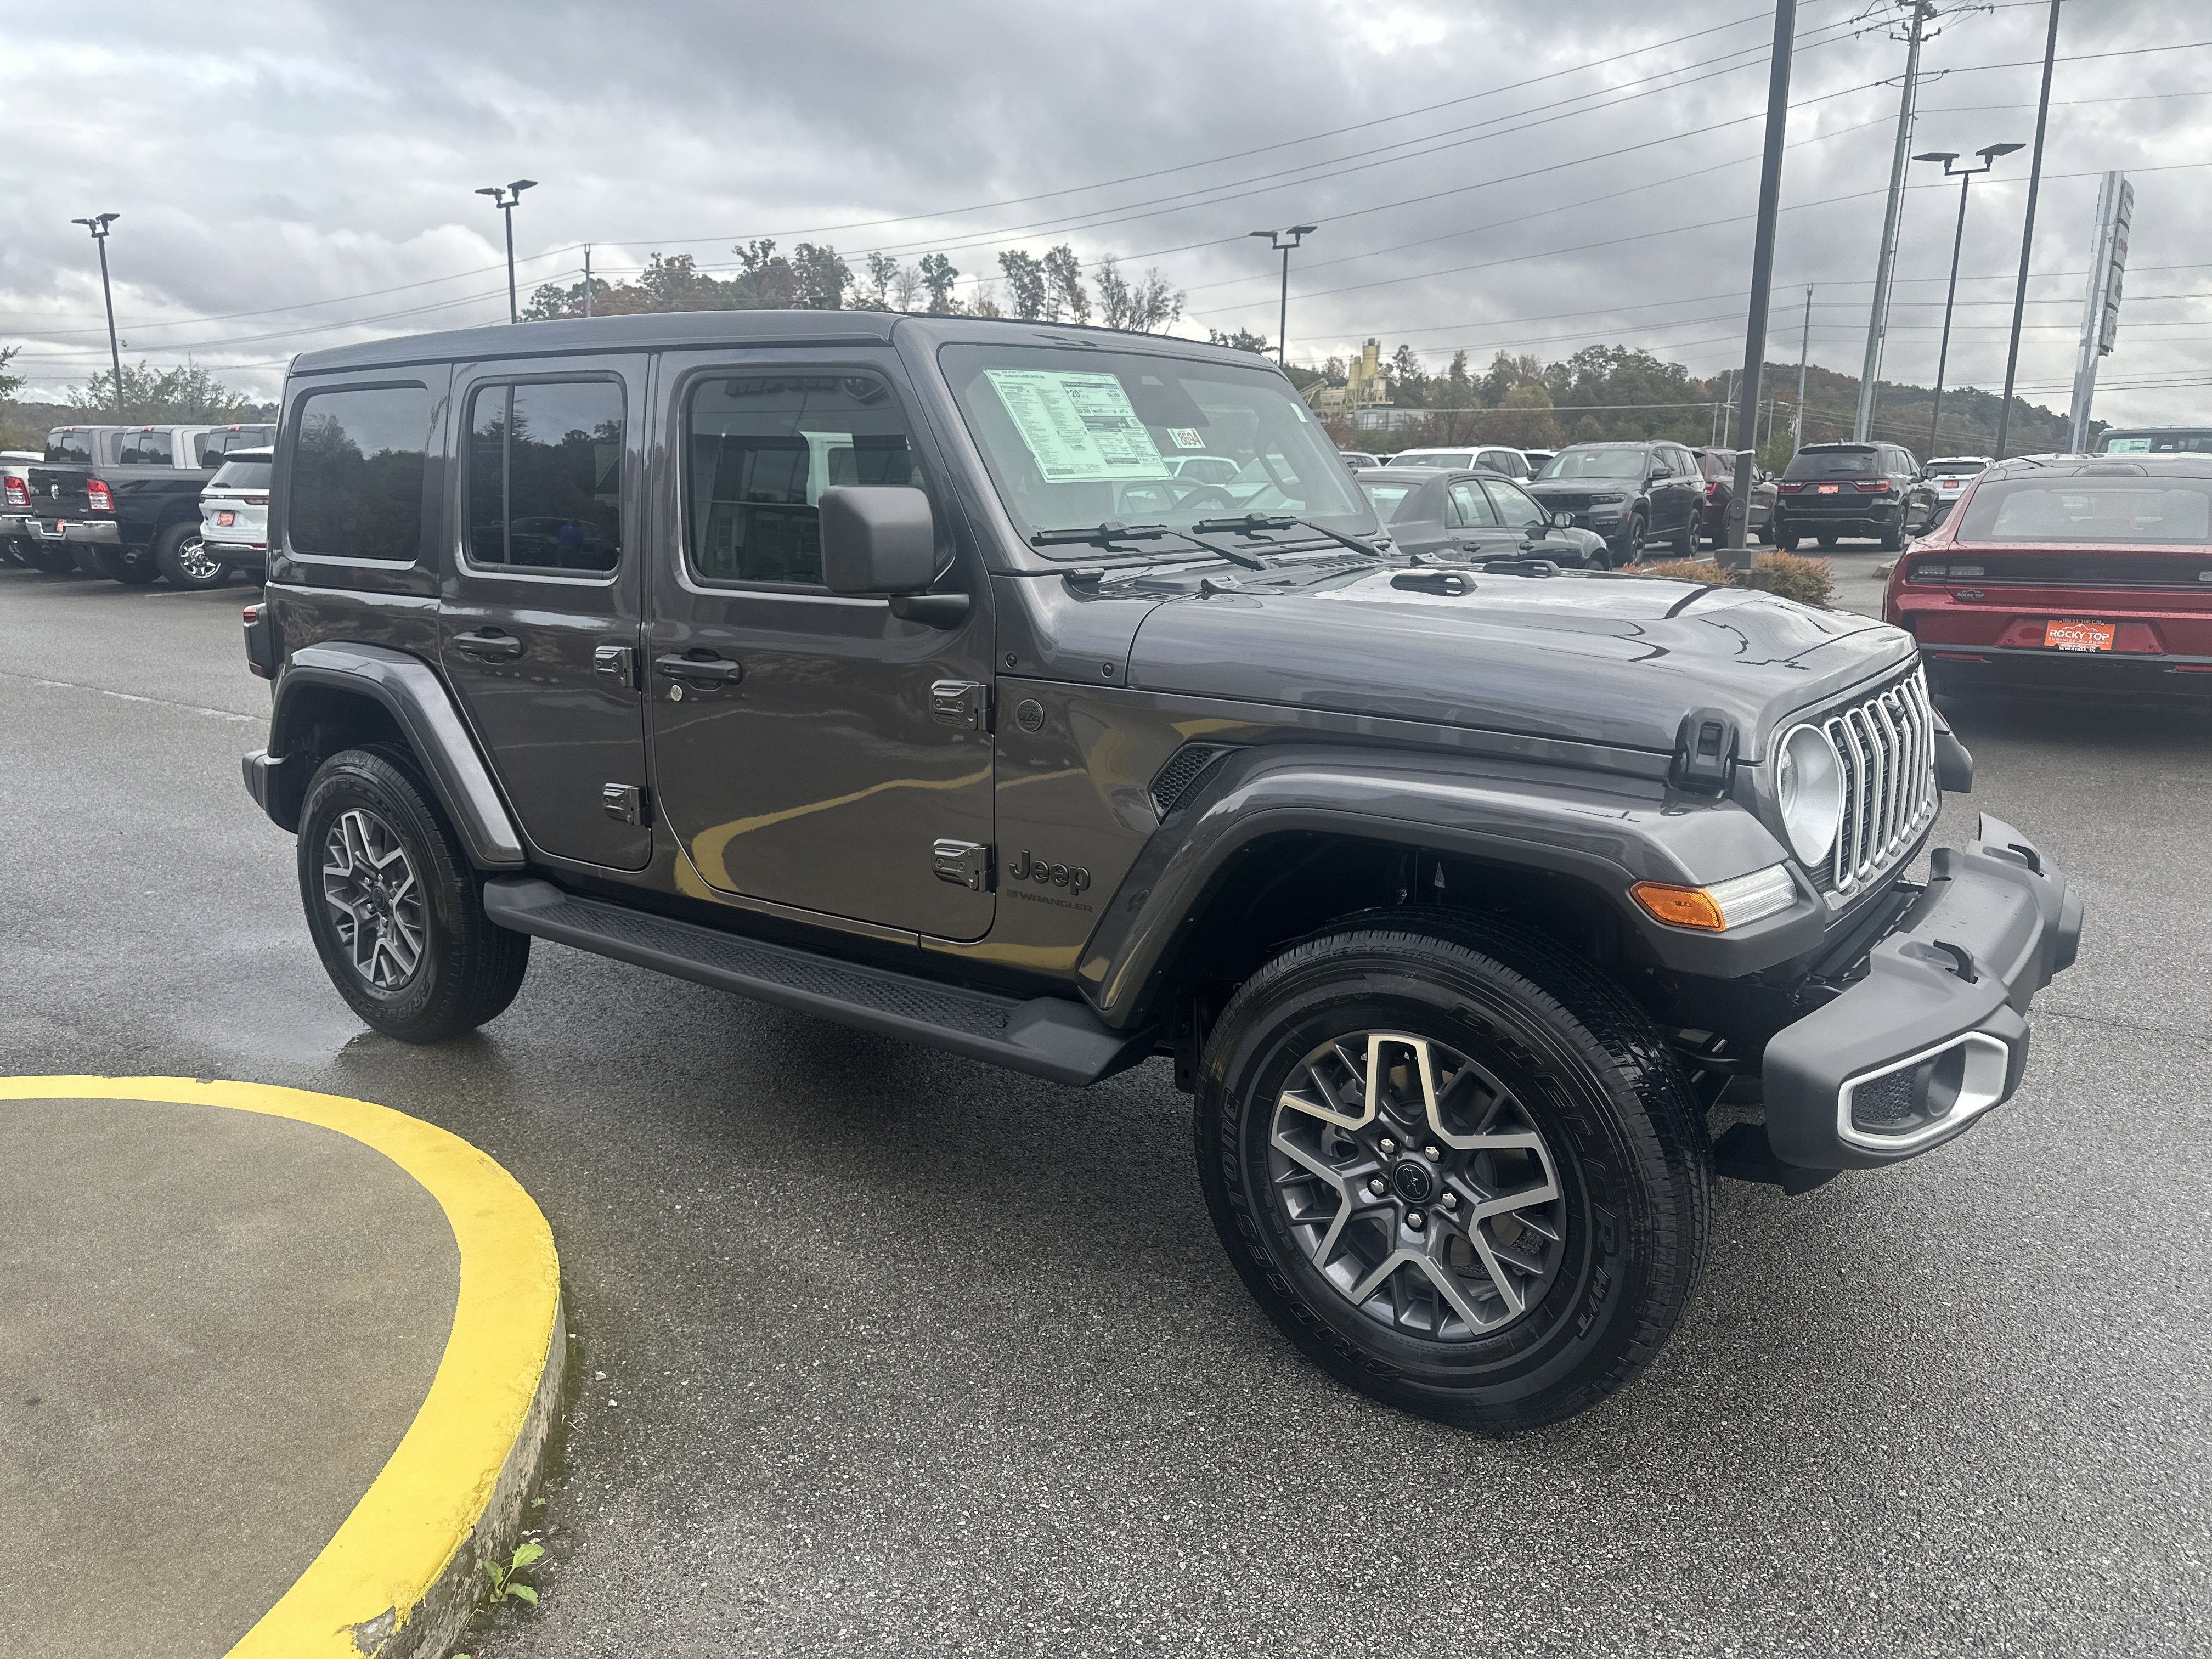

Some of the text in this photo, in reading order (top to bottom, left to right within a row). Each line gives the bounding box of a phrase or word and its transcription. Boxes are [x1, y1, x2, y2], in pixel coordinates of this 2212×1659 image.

[1070, 390, 1080, 398] 20
[1177, 432, 1201, 445] 8694
[2049, 629, 2110, 641] ROCKY TOP
[1009, 849, 1091, 896] Jeep
[1018, 891, 1093, 912] WRANGLER
[1444, 1003, 1619, 1258] DUELER
[1221, 1087, 1404, 1381] BRIDGESTONE
[1577, 1265, 1612, 1338] H/T
